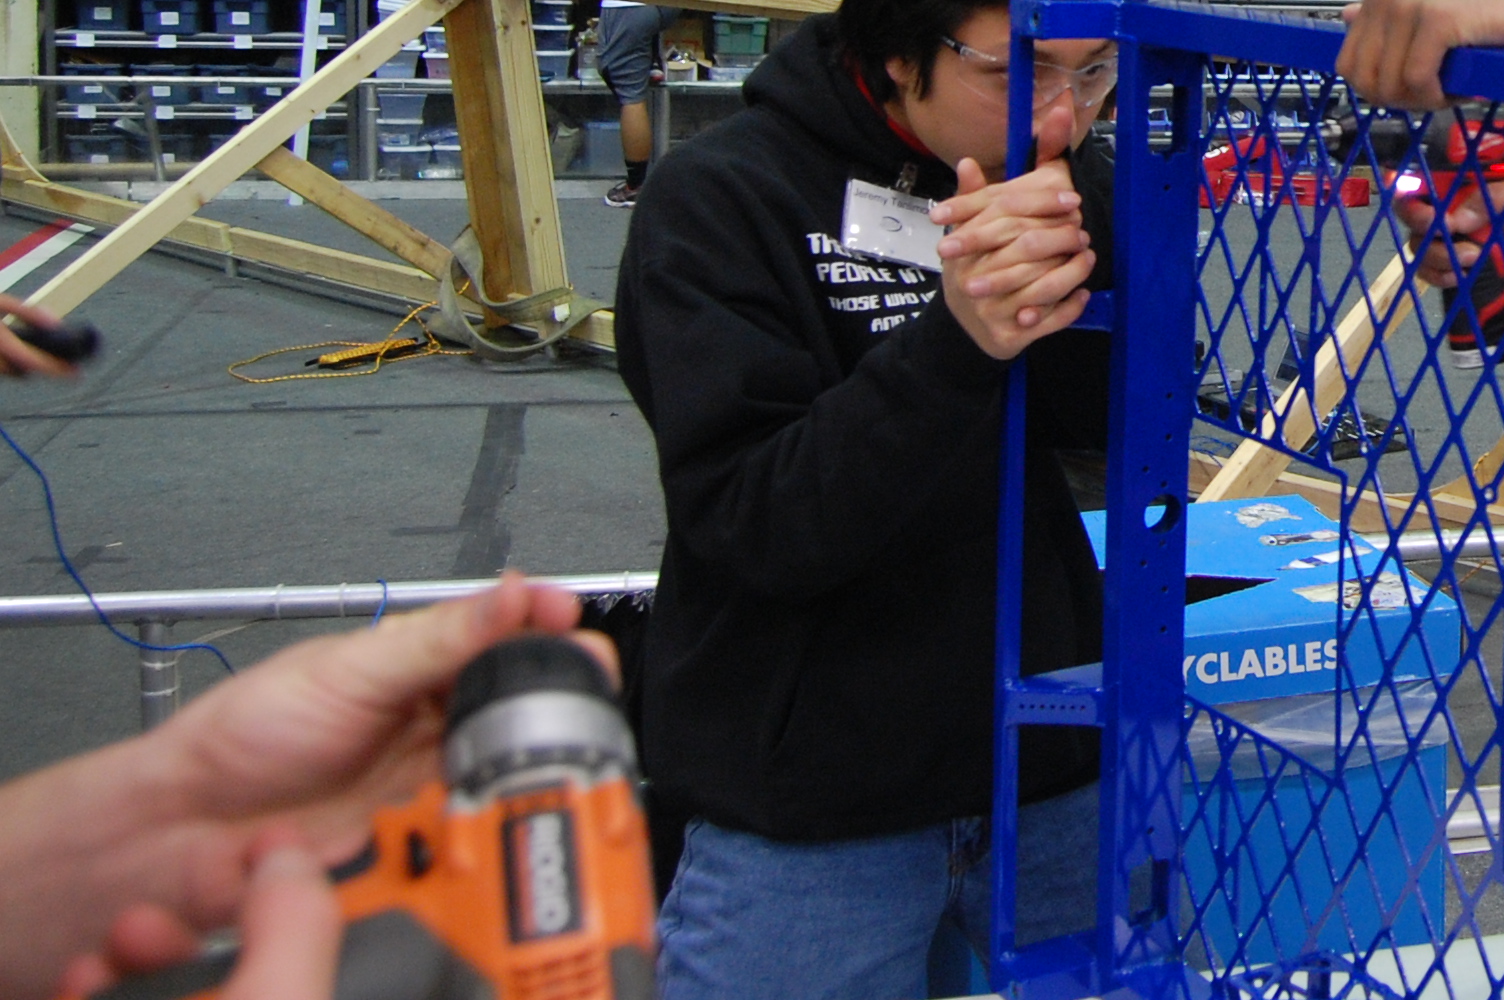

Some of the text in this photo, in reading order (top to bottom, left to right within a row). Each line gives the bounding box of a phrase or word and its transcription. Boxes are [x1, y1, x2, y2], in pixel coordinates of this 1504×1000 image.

[854, 187, 889, 206] Jeremy
[815, 261, 897, 284] PEOPLE
[828, 294, 881, 312] THOSE
[884, 292, 919, 308] WHO
[1182, 638, 1339, 685] YCLABLES
